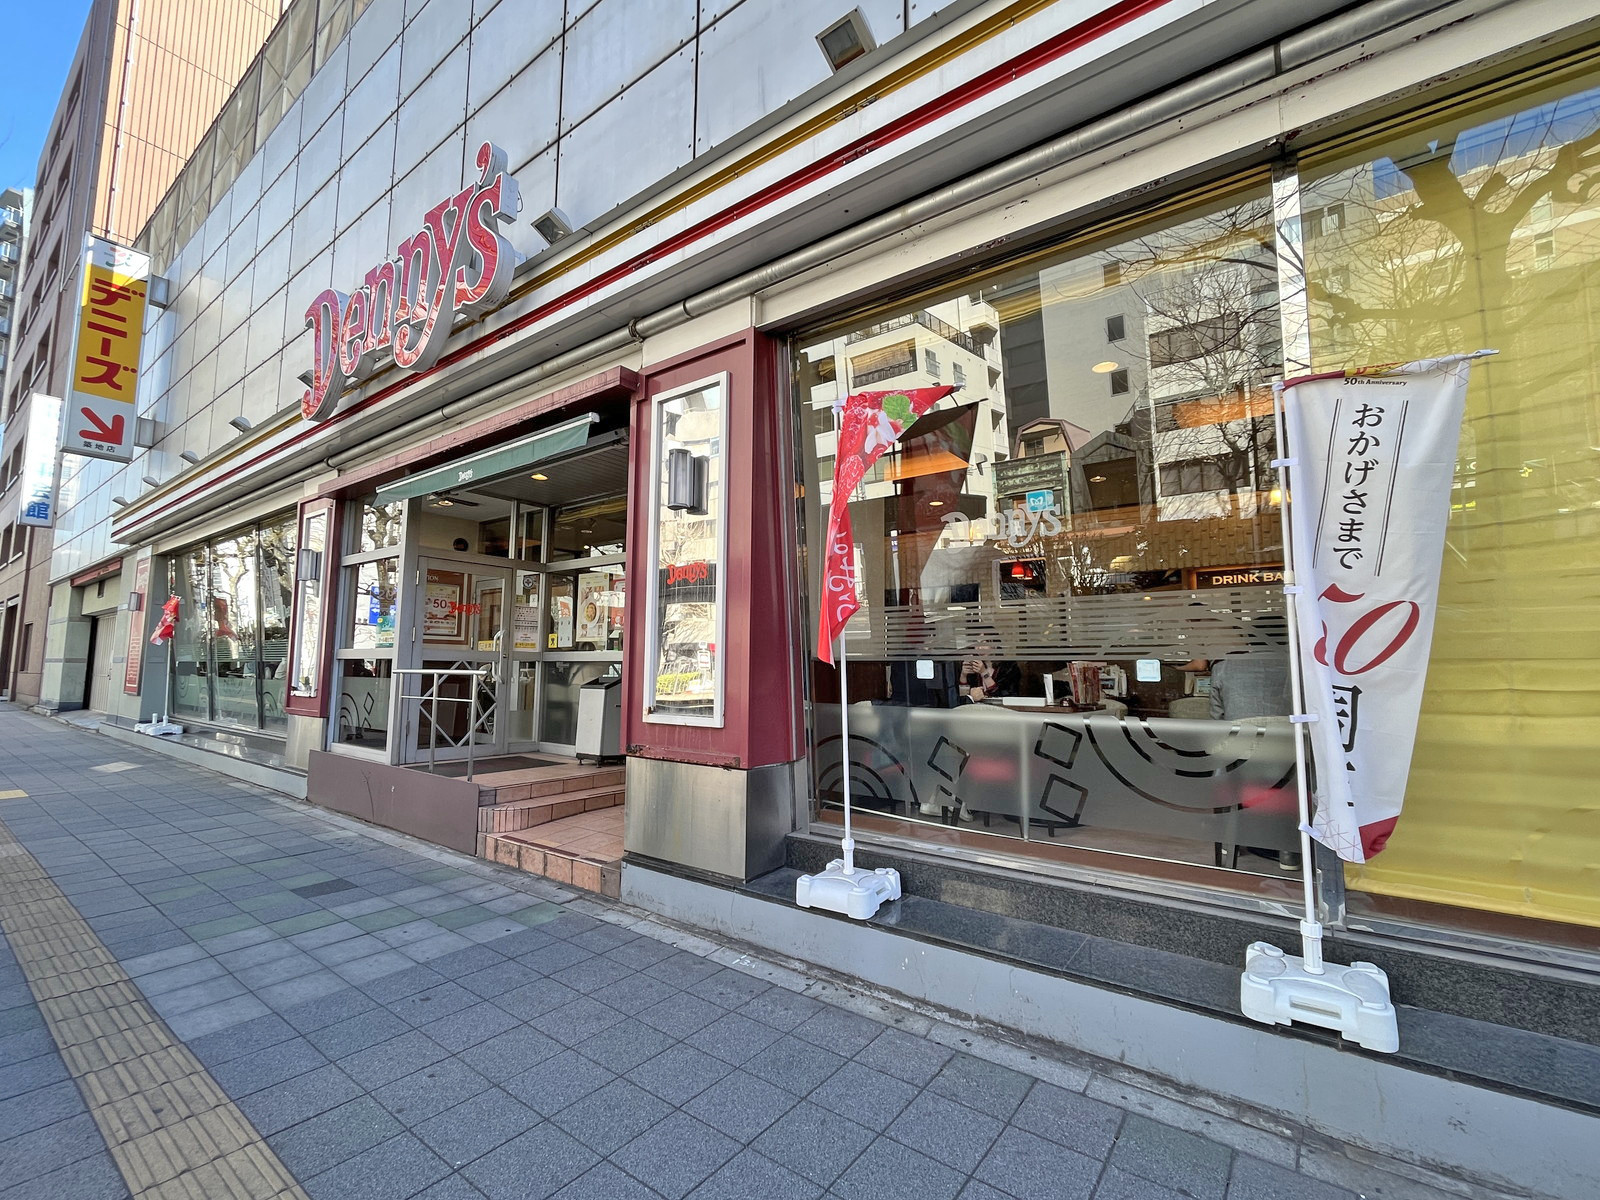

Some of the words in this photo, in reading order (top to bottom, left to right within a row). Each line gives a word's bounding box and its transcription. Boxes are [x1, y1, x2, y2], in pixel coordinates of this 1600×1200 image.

[80, 277, 146, 391] デニーズ
[301, 141, 503, 420] Denny's
[1343, 377, 1365, 386] 50th
[1365, 378, 1408, 387] Anniversary
[1332, 403, 1385, 570] おかげさまで
[1212, 573, 1261, 586] DRINK
[1263, 572, 1285, 583] BA
